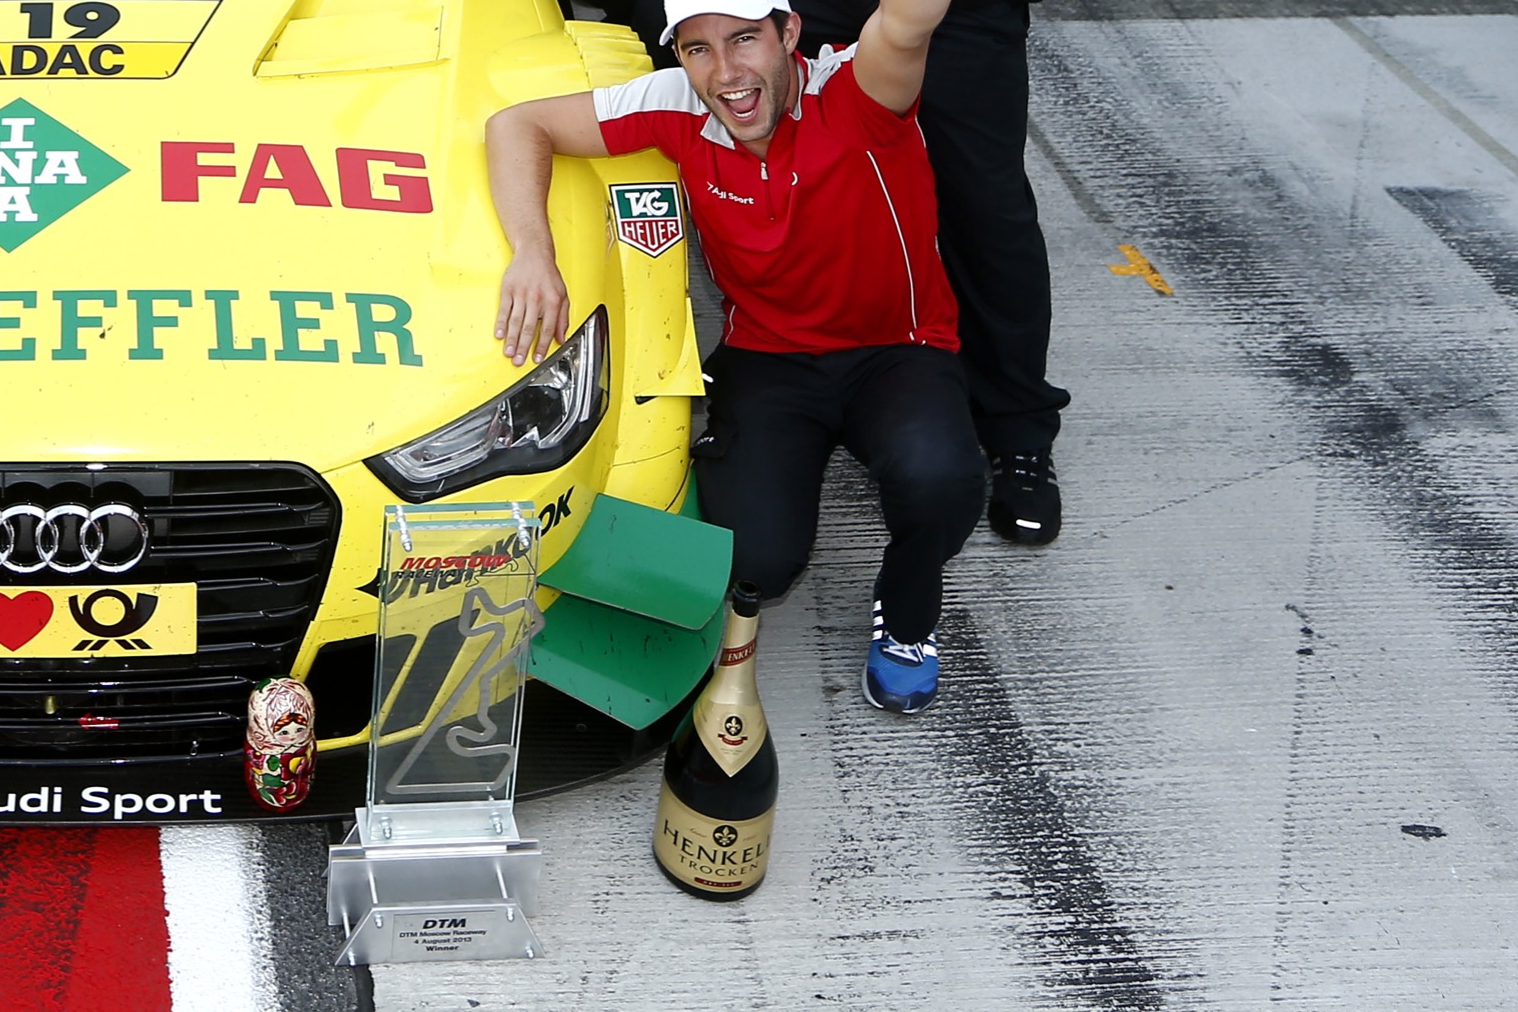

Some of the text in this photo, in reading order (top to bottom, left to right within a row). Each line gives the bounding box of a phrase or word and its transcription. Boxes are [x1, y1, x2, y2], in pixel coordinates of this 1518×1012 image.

[18, 1, 122, 40] 19
[160, 140, 434, 214] FAG
[624, 189, 669, 216] TAG
[624, 220, 677, 250] HEUER
[400, 555, 512, 570] MOSCOW
[80, 786, 223, 820] Sport
[679, 853, 759, 877] TROCKEN
[423, 918, 466, 929] DTM
